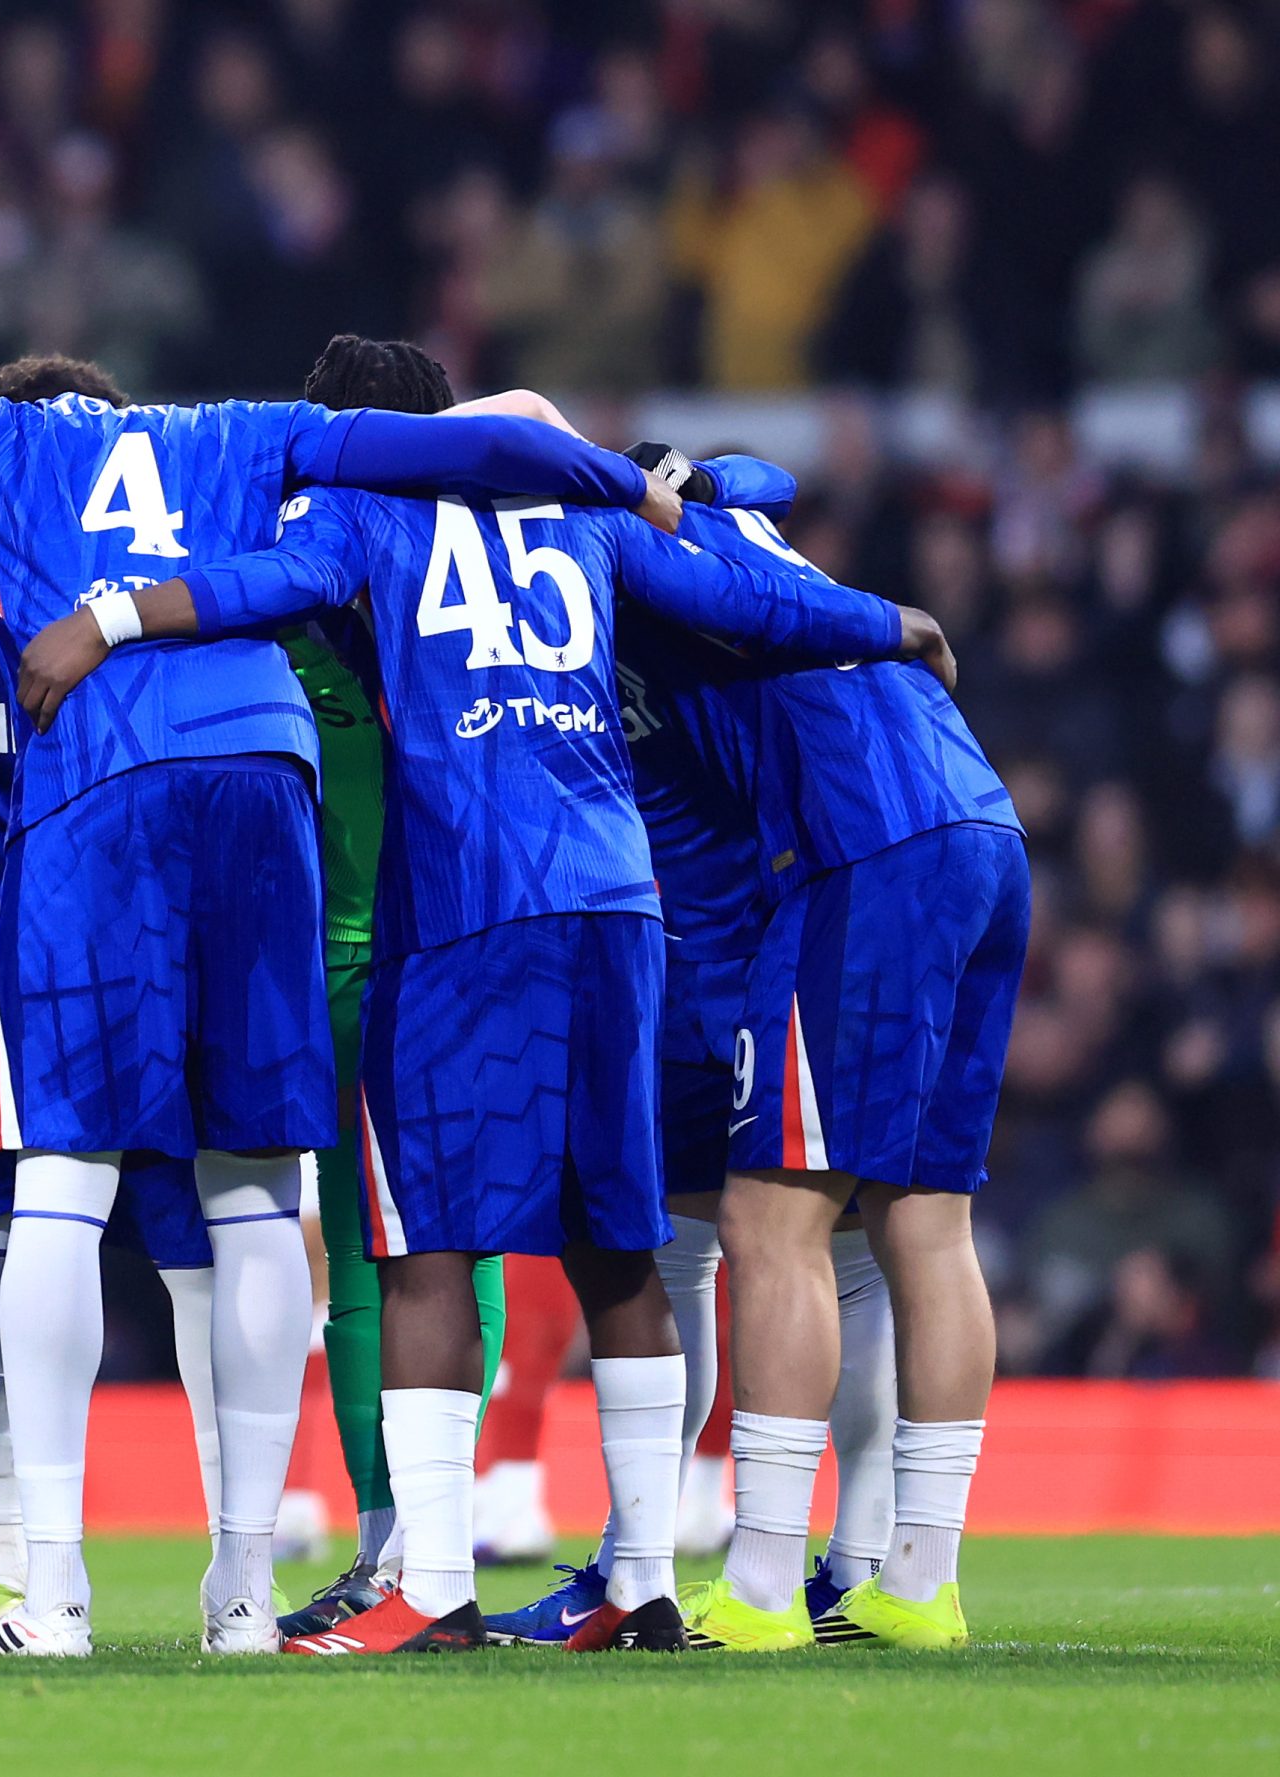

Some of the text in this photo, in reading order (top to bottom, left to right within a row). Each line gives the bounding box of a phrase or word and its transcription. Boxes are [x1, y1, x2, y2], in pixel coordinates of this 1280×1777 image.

[81, 431, 189, 558] 4
[416, 494, 595, 673] 45
[733, 1029, 755, 1110] 9
